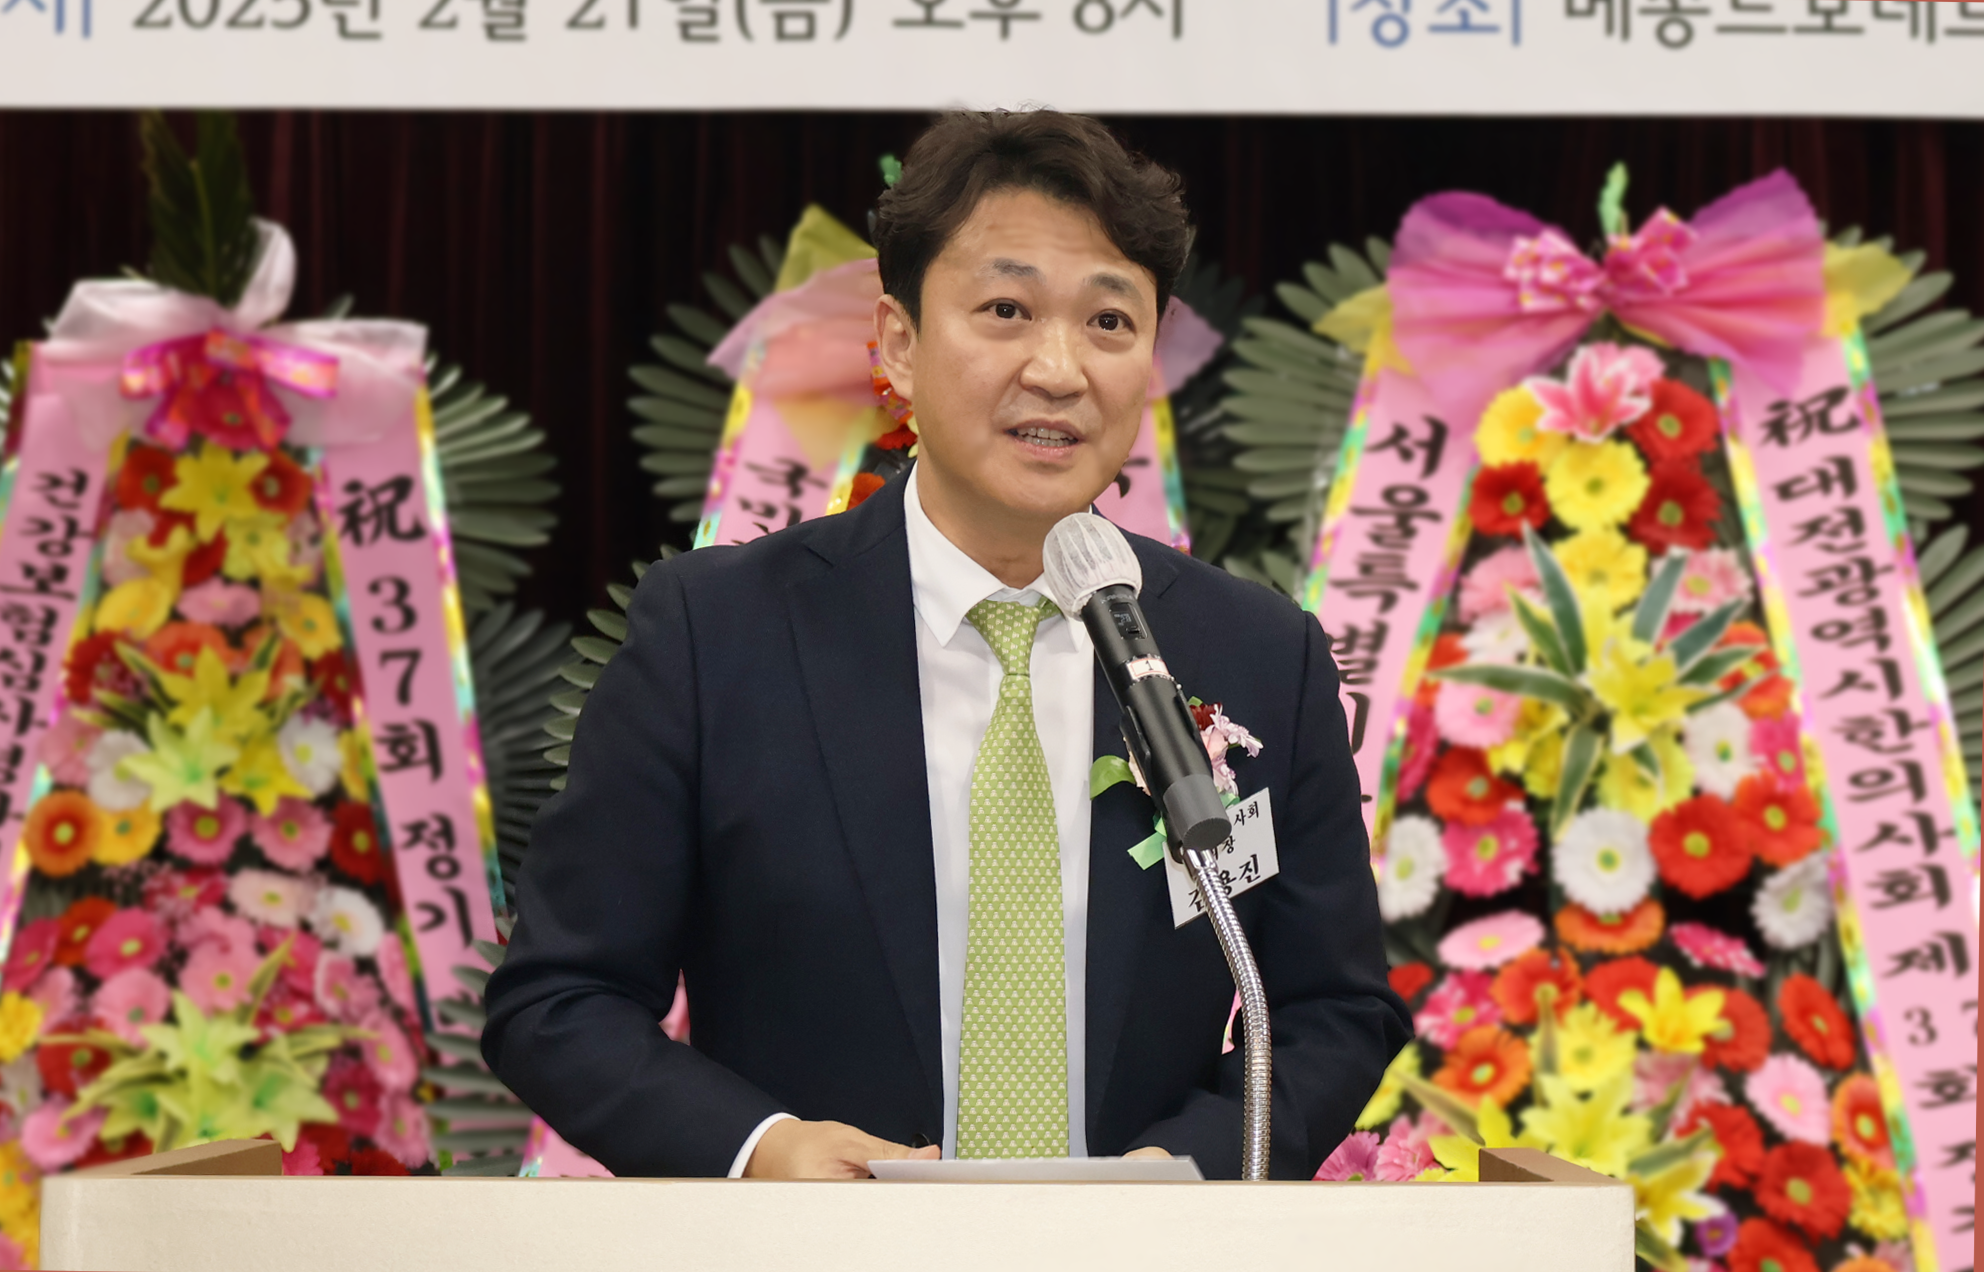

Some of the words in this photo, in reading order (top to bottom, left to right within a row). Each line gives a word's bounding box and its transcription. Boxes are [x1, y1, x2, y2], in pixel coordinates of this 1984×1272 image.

[417, 0, 527, 41] 2월
[891, 0, 1042, 40] 오후
[1758, 384, 1861, 447] 祝
[337, 475, 426, 545] 祝
[1326, 414, 1449, 803] 서울특별
[367, 575, 443, 785] 37회
[1770, 453, 1956, 912] 대전광역시한의사회
[399, 813, 474, 949] 정기
